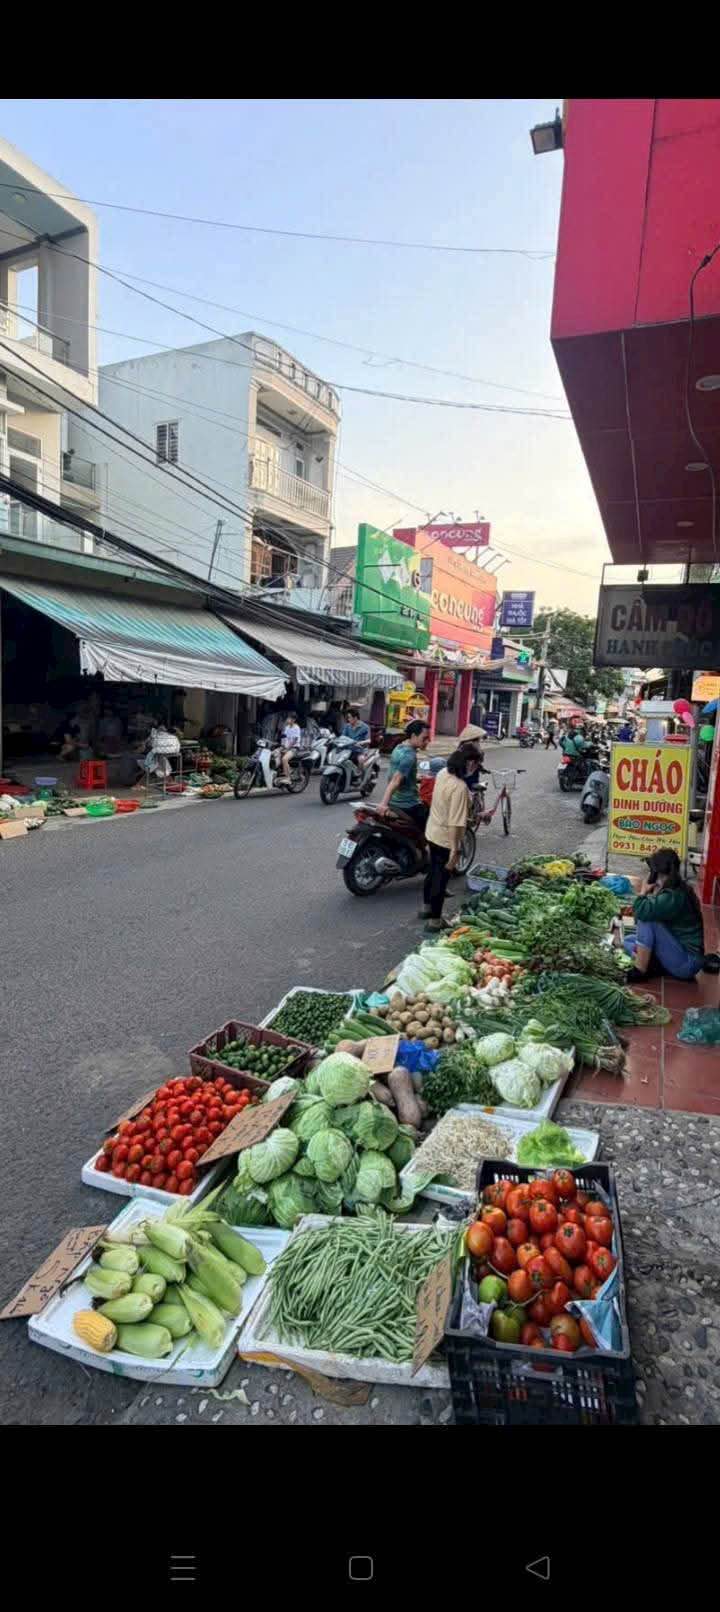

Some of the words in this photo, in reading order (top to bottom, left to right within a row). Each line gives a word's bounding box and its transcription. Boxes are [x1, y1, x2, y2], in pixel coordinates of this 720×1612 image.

[616, 749, 683, 794] CHÁO
[613, 799, 640, 810] DINH
[613, 841, 636, 850] 0931
